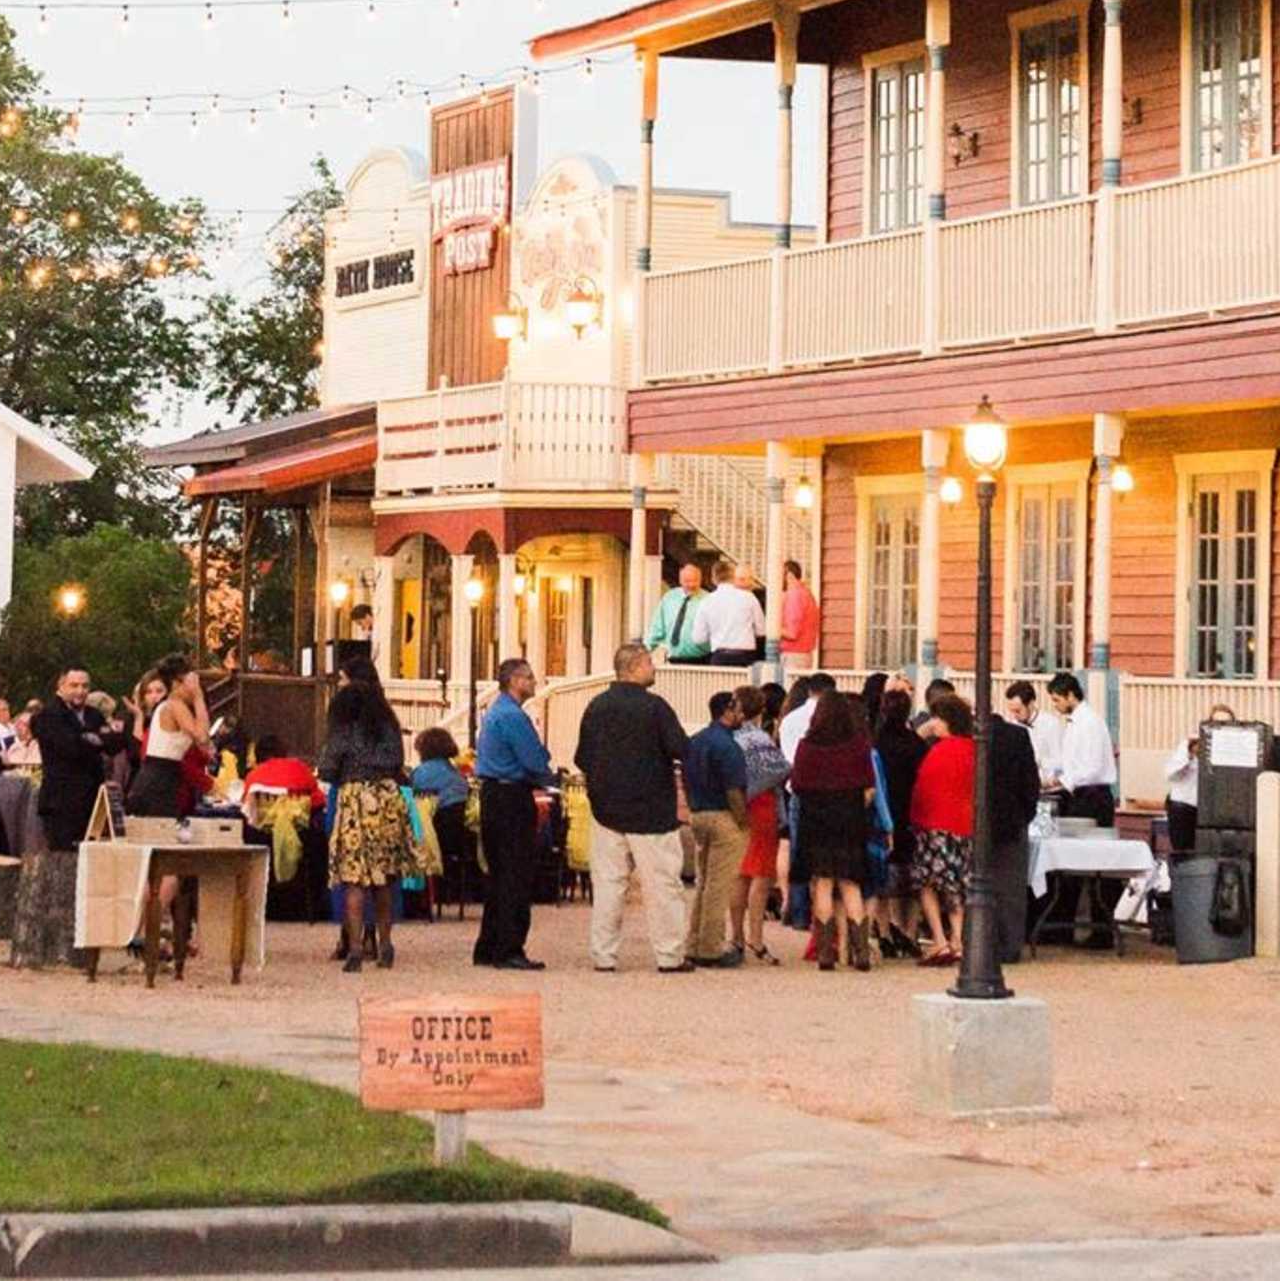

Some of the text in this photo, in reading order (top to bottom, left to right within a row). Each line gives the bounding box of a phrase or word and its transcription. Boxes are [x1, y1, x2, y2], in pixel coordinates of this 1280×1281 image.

[444, 230, 491, 267] POST
[412, 1016, 493, 1041] OFFICE
[377, 1048, 529, 1071] By Appointment
[432, 1070, 475, 1090] Only
